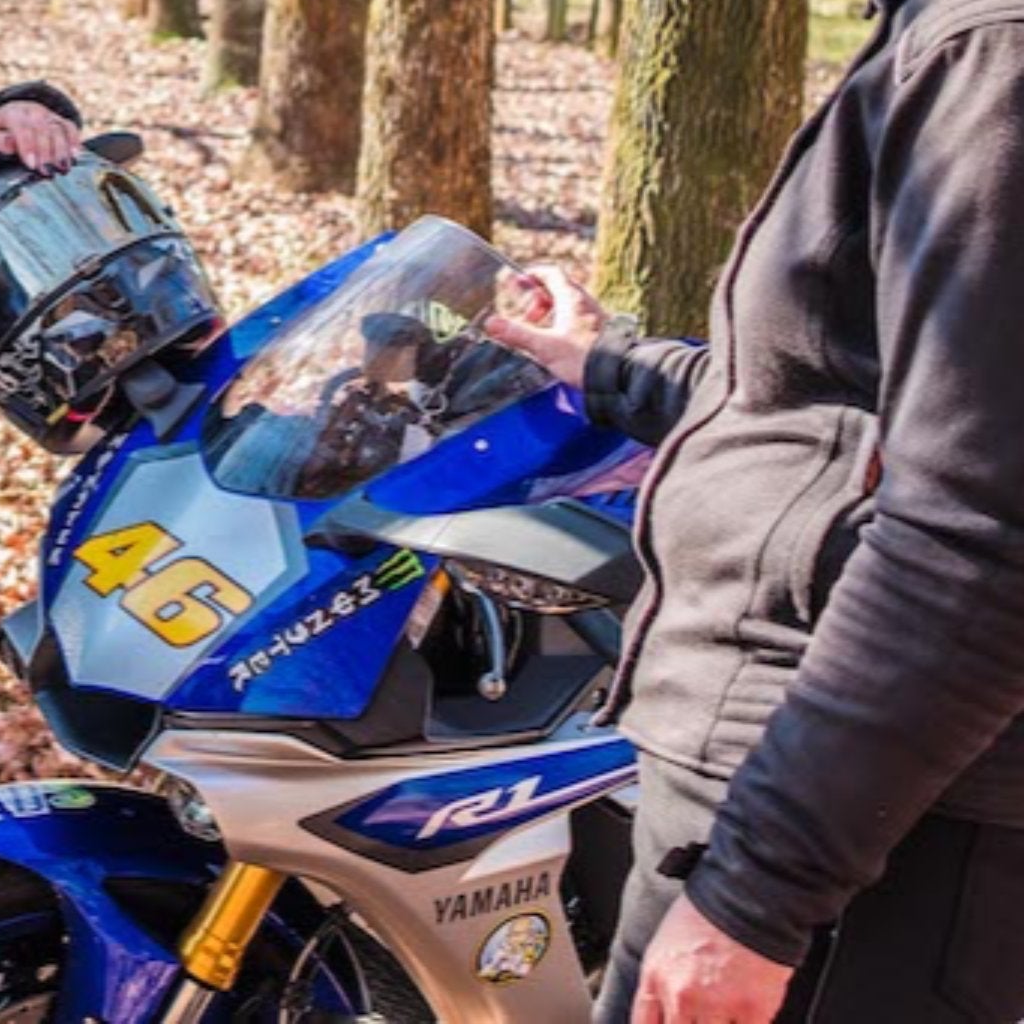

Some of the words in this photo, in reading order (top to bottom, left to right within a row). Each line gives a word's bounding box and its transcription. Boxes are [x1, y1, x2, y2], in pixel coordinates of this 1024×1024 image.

[72, 520, 257, 649] 46
[417, 775, 542, 839] R1
[433, 872, 551, 923] YAMAHA
